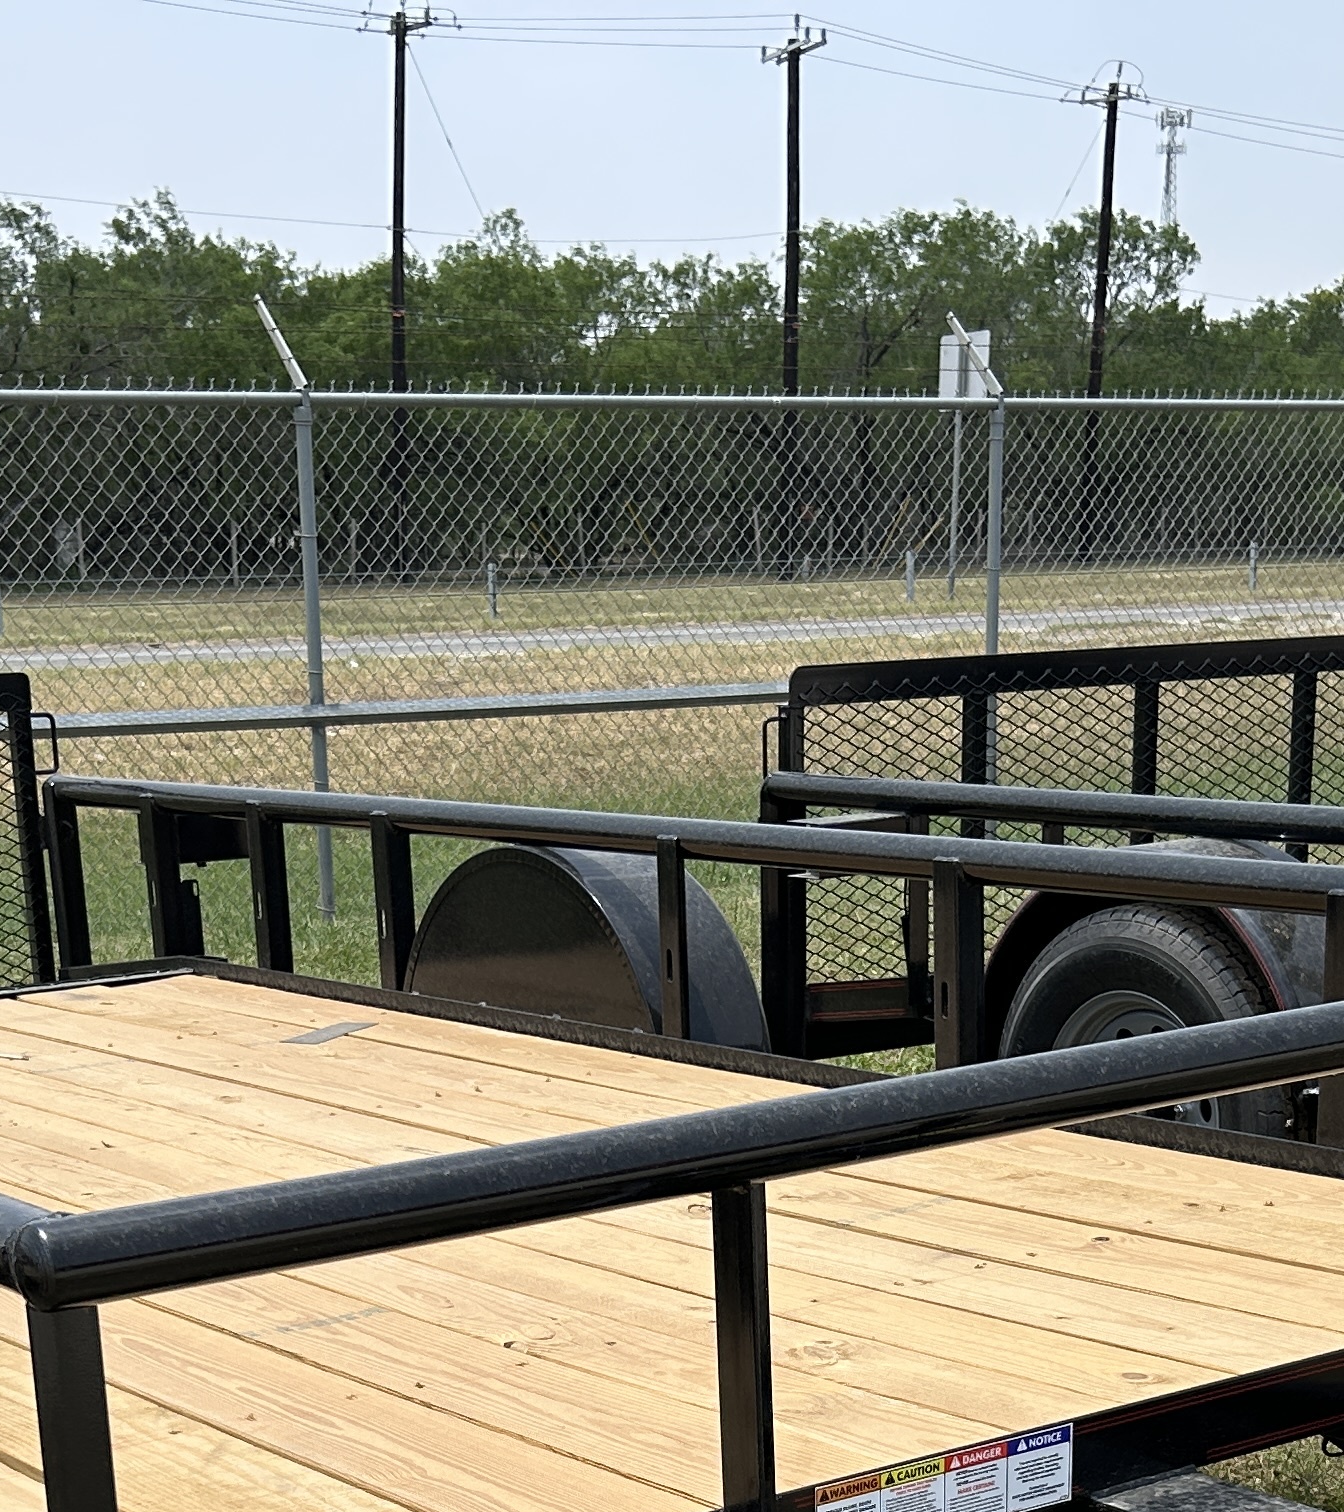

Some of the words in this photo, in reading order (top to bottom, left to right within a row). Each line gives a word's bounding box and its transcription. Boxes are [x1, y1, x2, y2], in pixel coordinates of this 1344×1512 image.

[1028, 1431, 1062, 1448] NOTICE
[962, 1447, 1002, 1465] DANGER
[896, 1462, 941, 1481] CAUTION
[830, 1478, 879, 1500] WARNING
